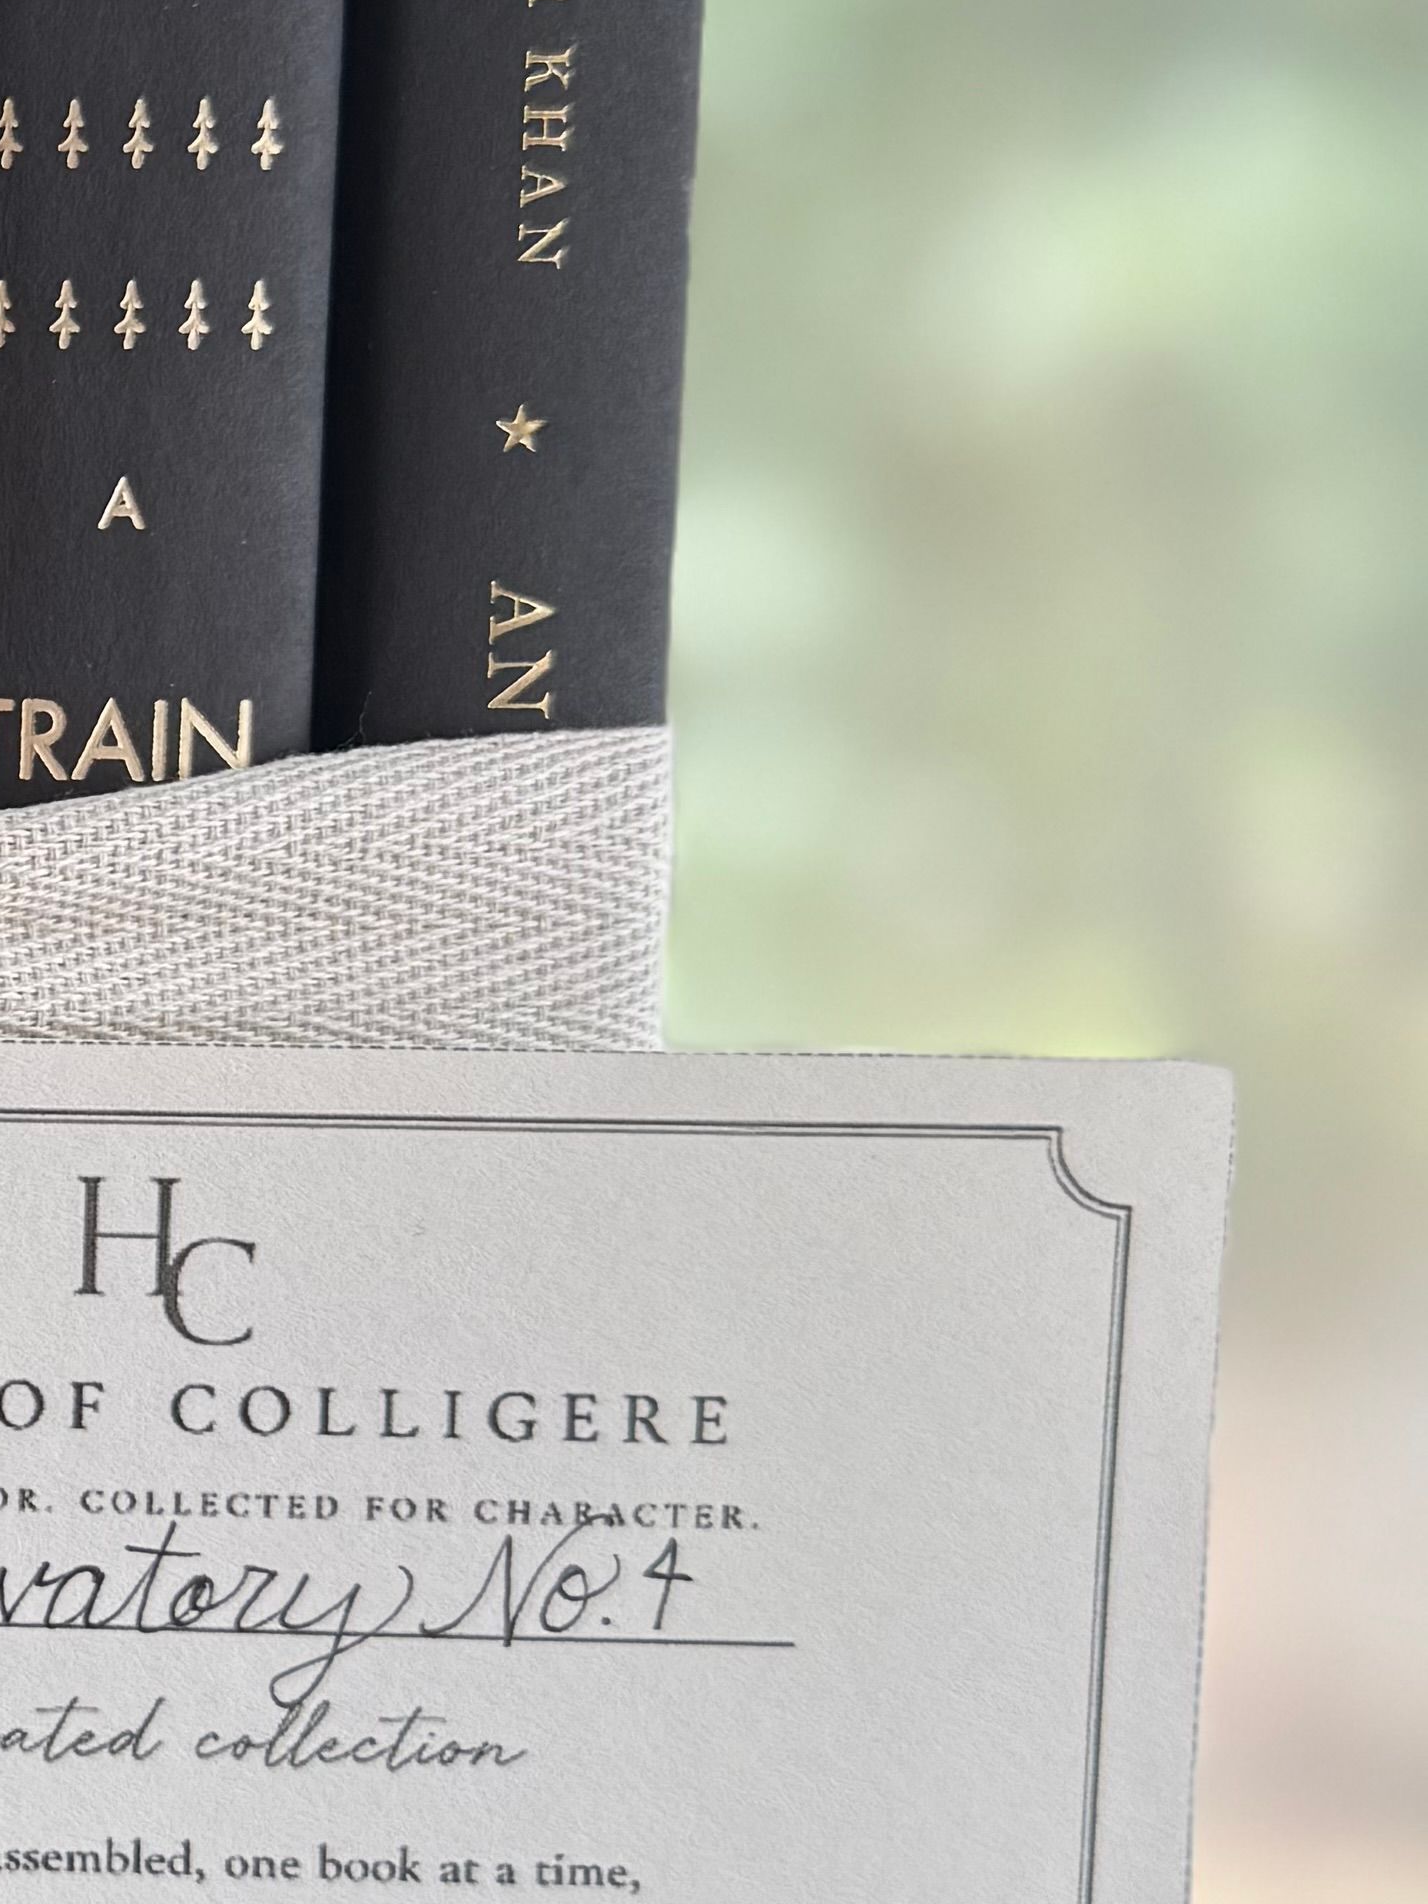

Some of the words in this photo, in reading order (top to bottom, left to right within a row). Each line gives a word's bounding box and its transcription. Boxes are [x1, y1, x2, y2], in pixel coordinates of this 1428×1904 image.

[517, 47, 572, 270] KHAN
[97, 476, 145, 530] A
[487, 580, 555, 720] AN
[170, 1383, 728, 1445] COLLIGERE
[79, 1489, 339, 1520] COLLECTED
[366, 1496, 448, 1523] FOR
[469, 1494, 766, 1536] CHARACTER.
[195, 1695, 527, 1773] collection
[225, 1855, 300, 1880] one
[319, 1843, 421, 1883] book
[440, 1859, 480, 1885] at
[496, 1863, 516, 1886] a
[535, 1853, 641, 1895] time,
